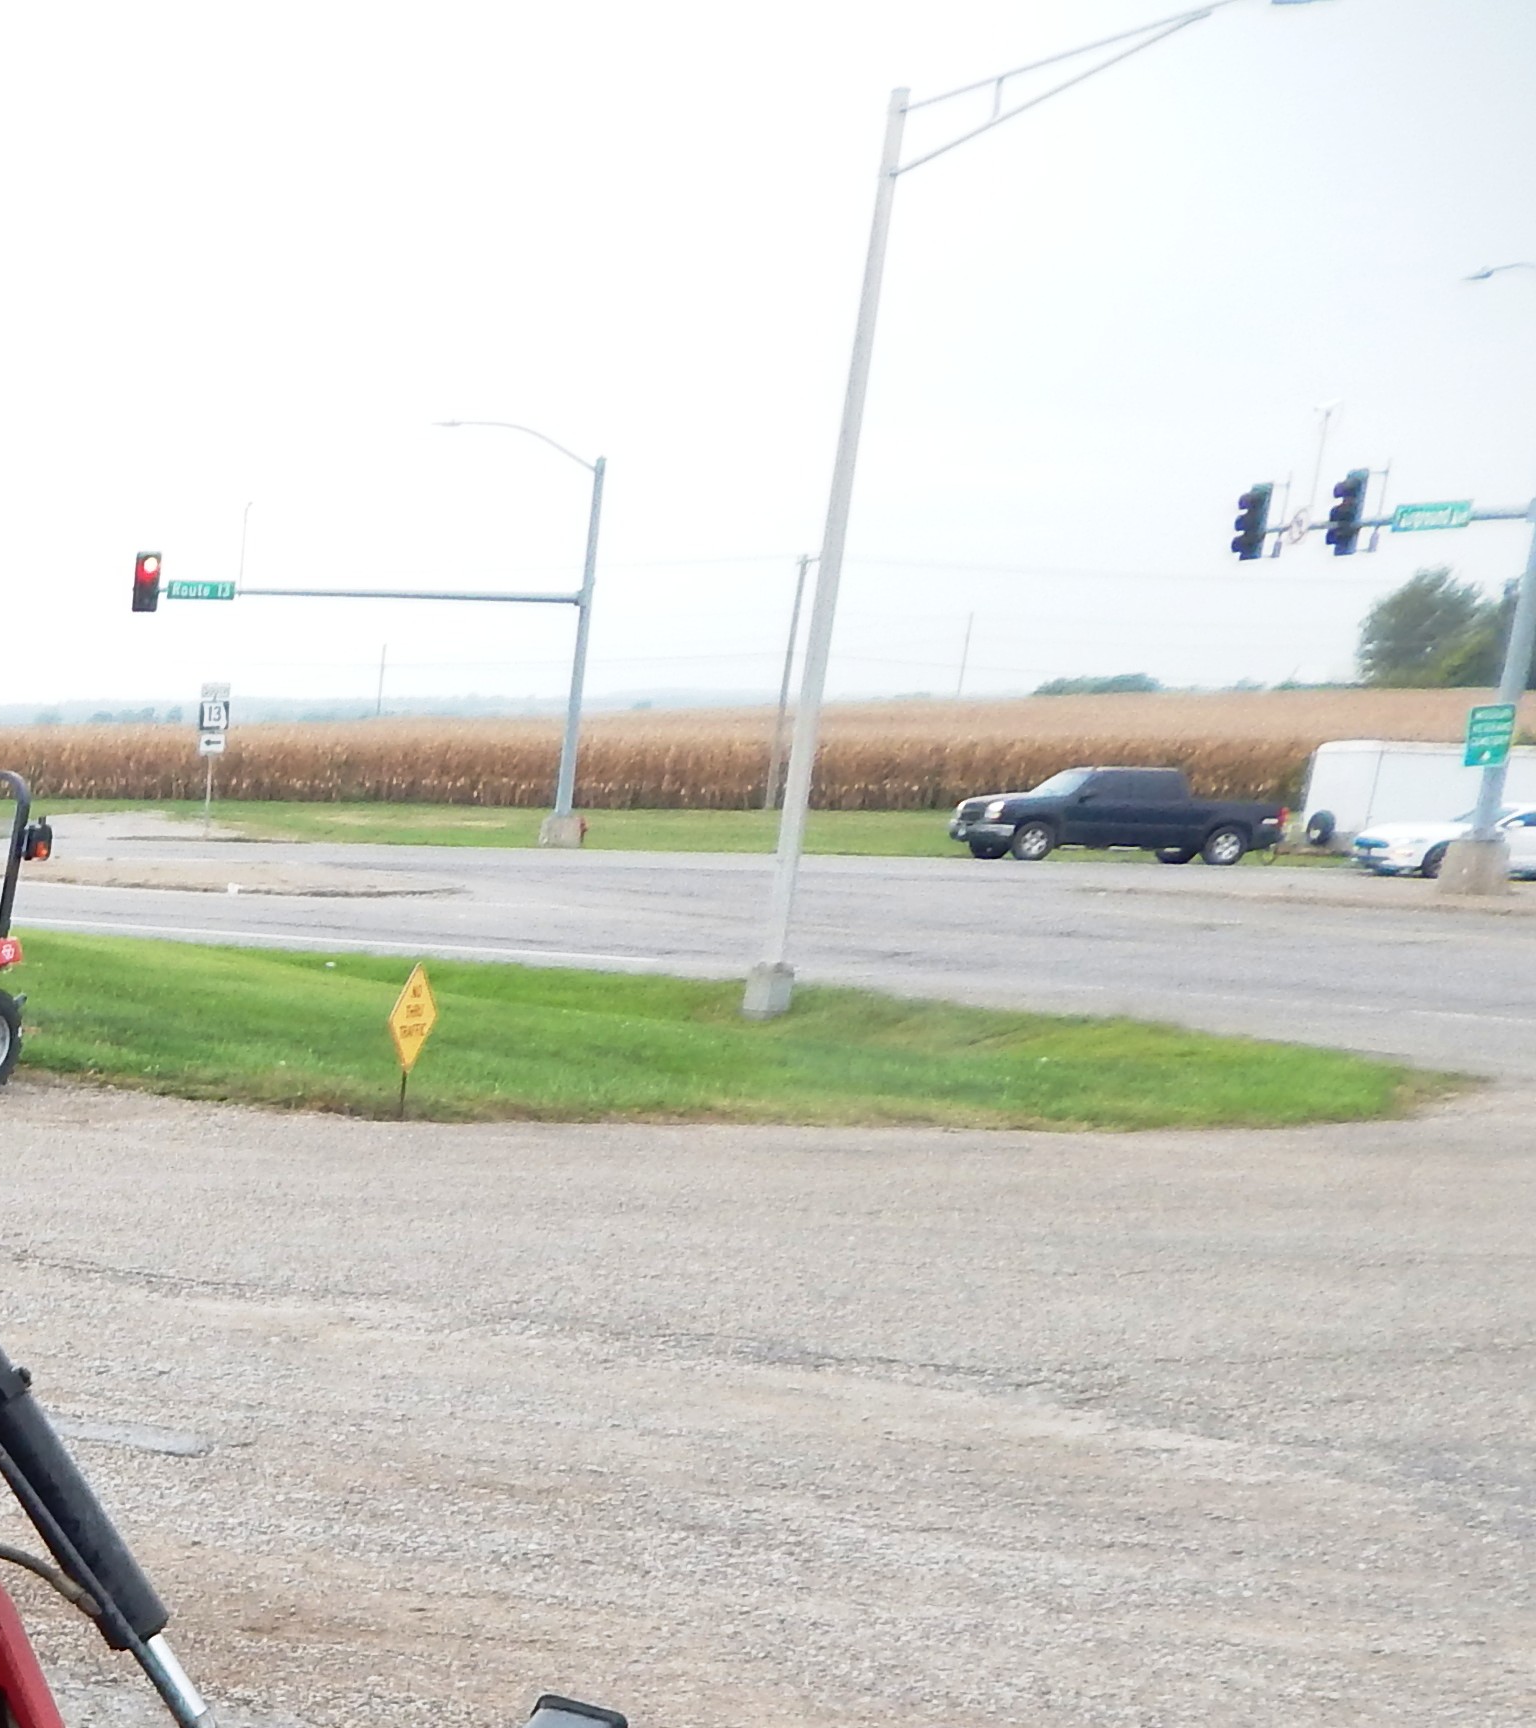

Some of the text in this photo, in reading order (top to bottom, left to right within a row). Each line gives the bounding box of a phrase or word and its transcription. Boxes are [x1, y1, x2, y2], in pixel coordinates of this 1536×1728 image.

[171, 582, 231, 597] Route 13
[208, 705, 222, 722] 13
